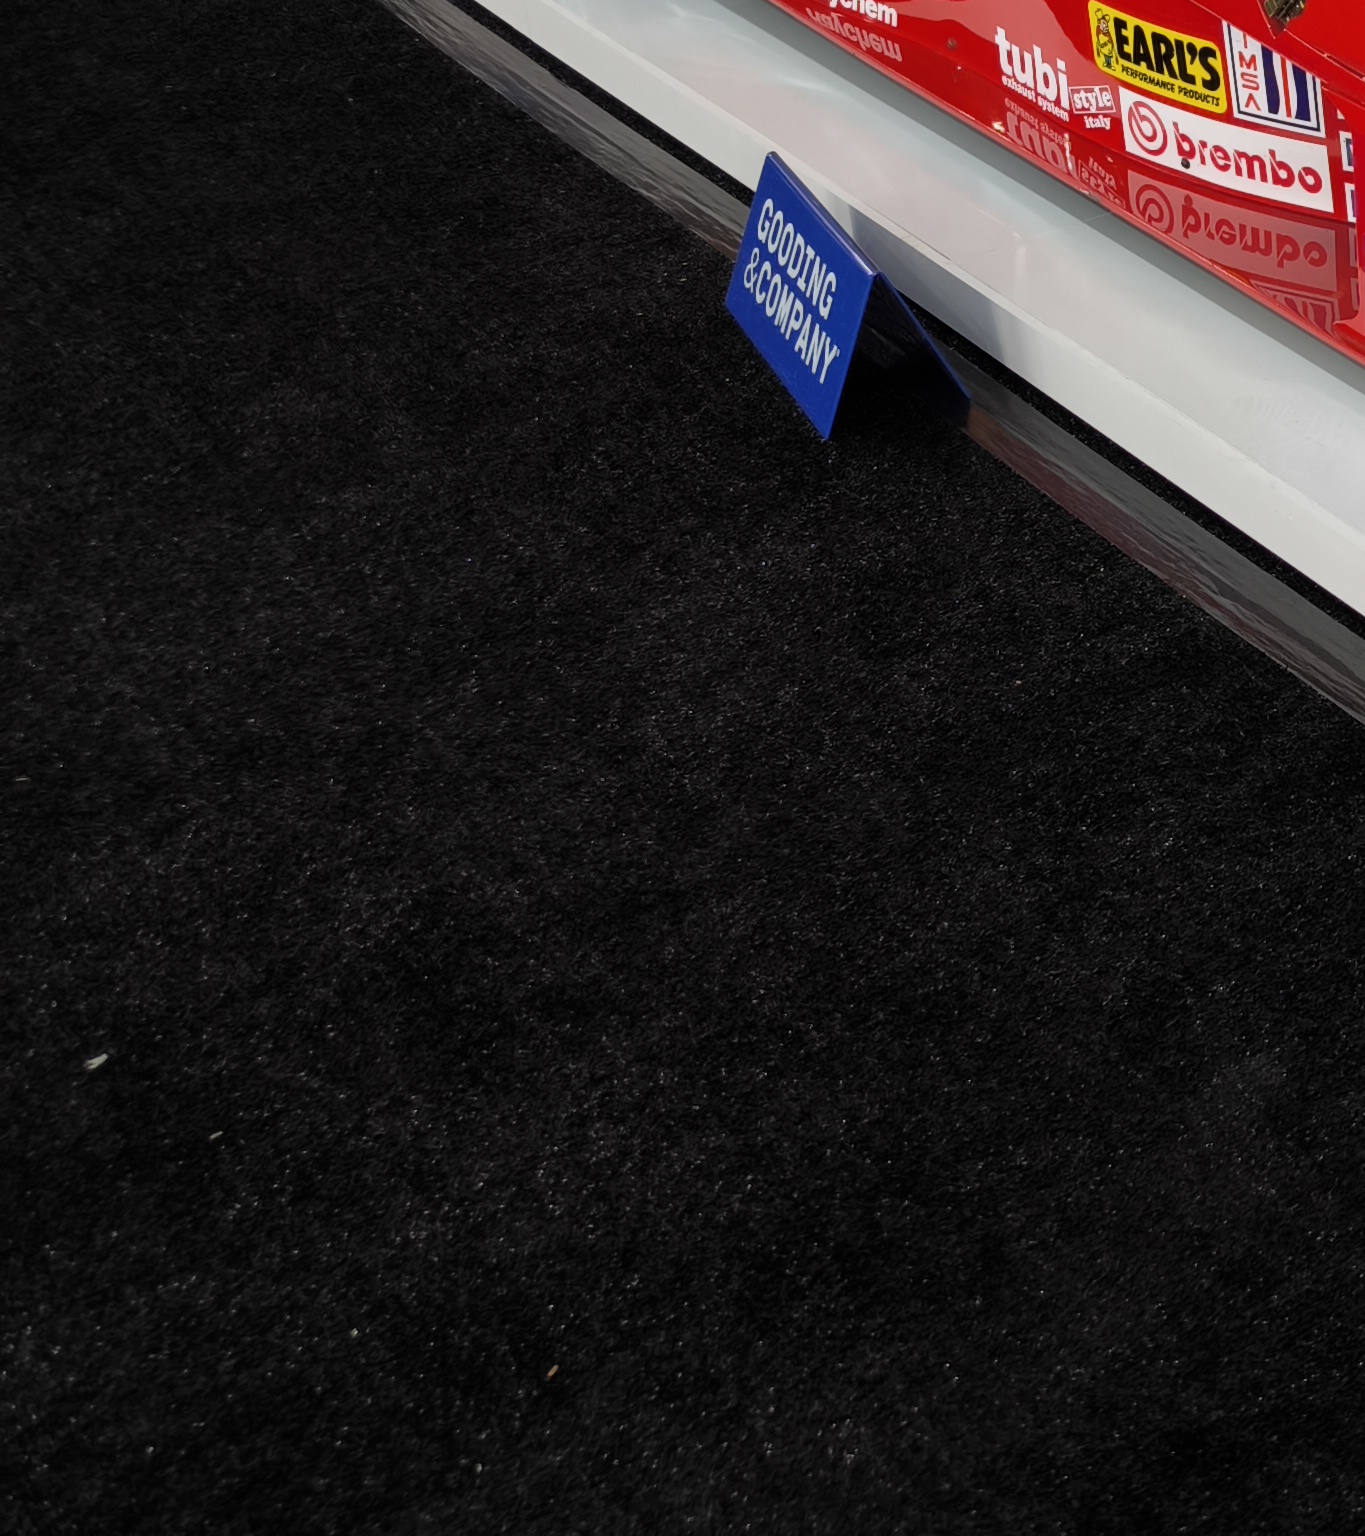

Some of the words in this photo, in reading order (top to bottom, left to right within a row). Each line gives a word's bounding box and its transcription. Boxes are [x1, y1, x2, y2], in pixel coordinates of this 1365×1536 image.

[994, 25, 1071, 110] tubi
[1113, 16, 1221, 92] EARL'S
[1001, 75, 1037, 104] exhaust
[1037, 97, 1069, 123] system
[1072, 86, 1113, 113] style
[1120, 64, 1175, 93] PERFORMANCE
[1178, 85, 1221, 107] PRODUCTS
[1084, 114, 1112, 131] italy
[1173, 122, 1322, 194] brembo
[757, 198, 837, 320] GOODING
